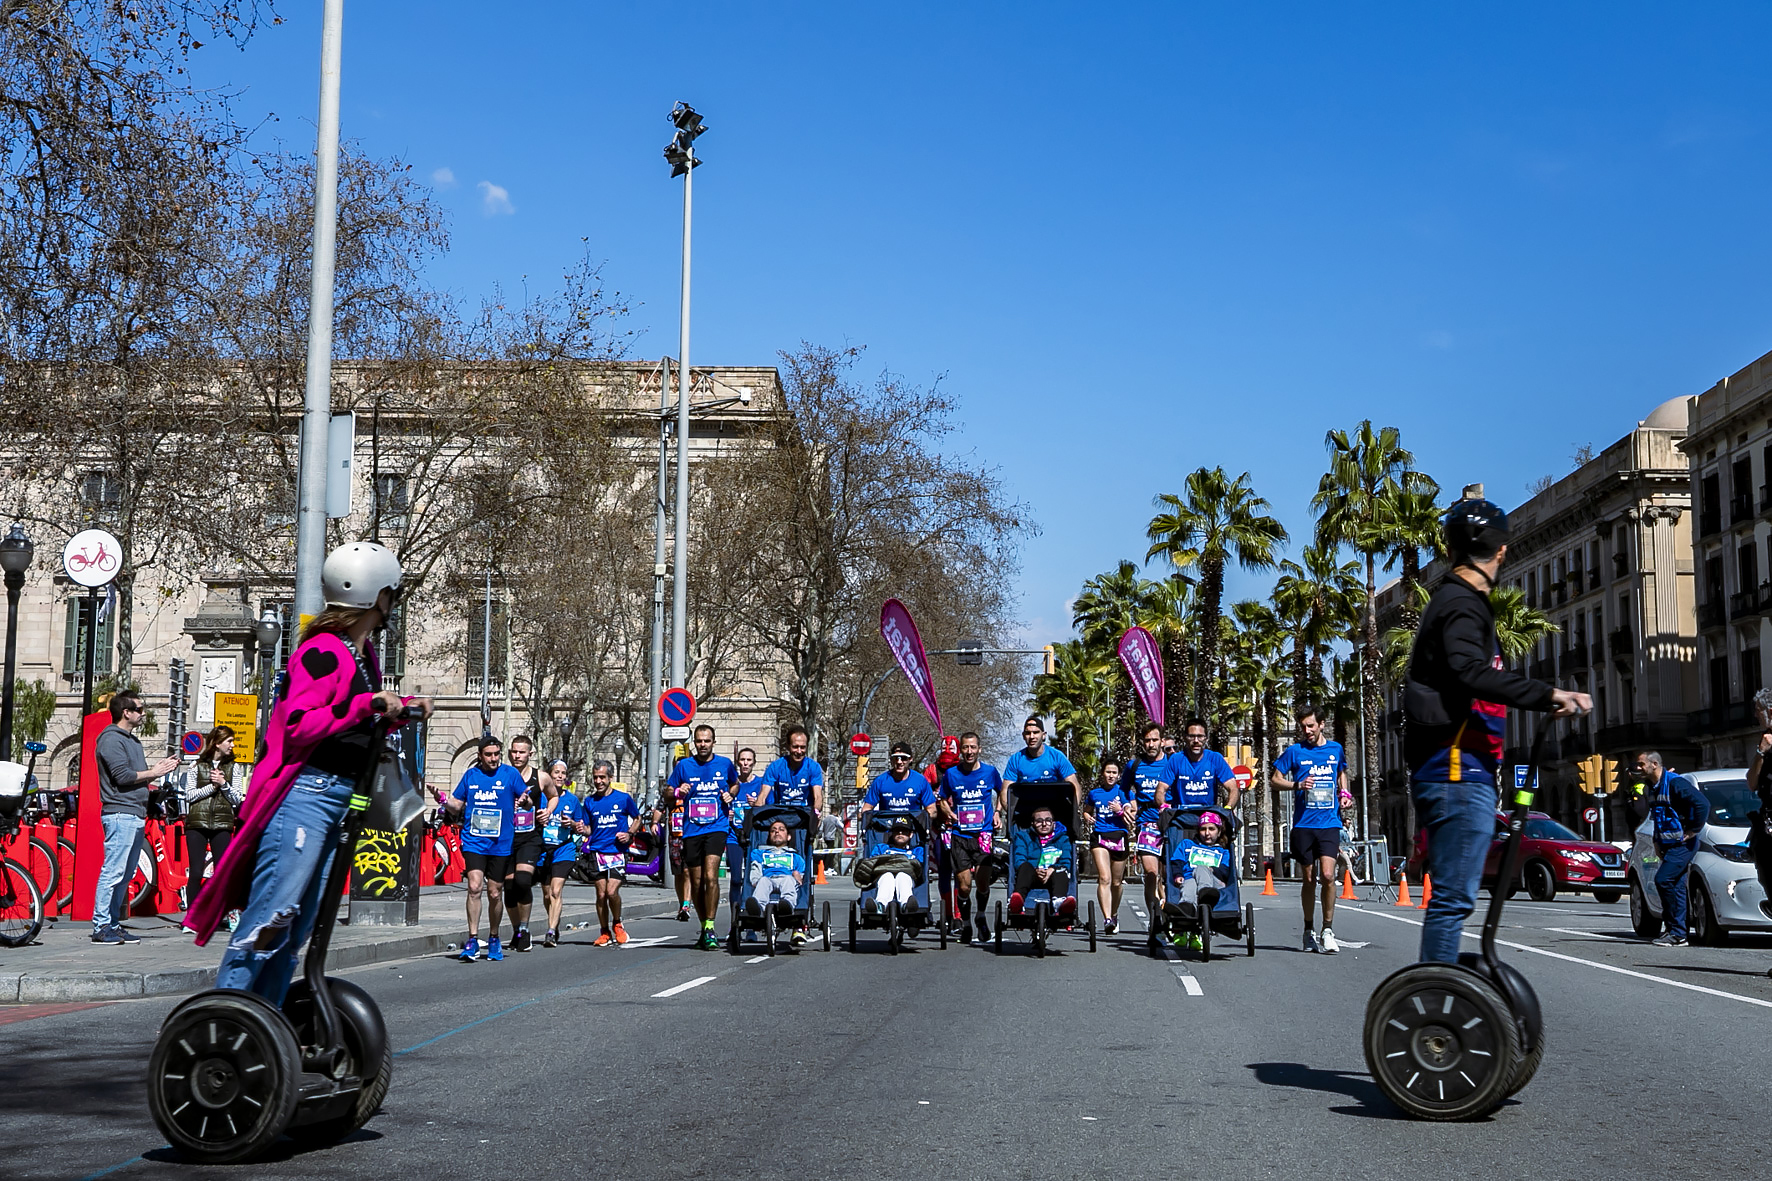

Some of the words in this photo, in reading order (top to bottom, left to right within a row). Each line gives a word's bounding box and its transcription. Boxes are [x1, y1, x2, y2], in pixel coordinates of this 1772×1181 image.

[223, 696, 249, 706] ATENCIÓ
[1511, 820, 1522, 831] 2
[340, 832, 350, 844] 2
